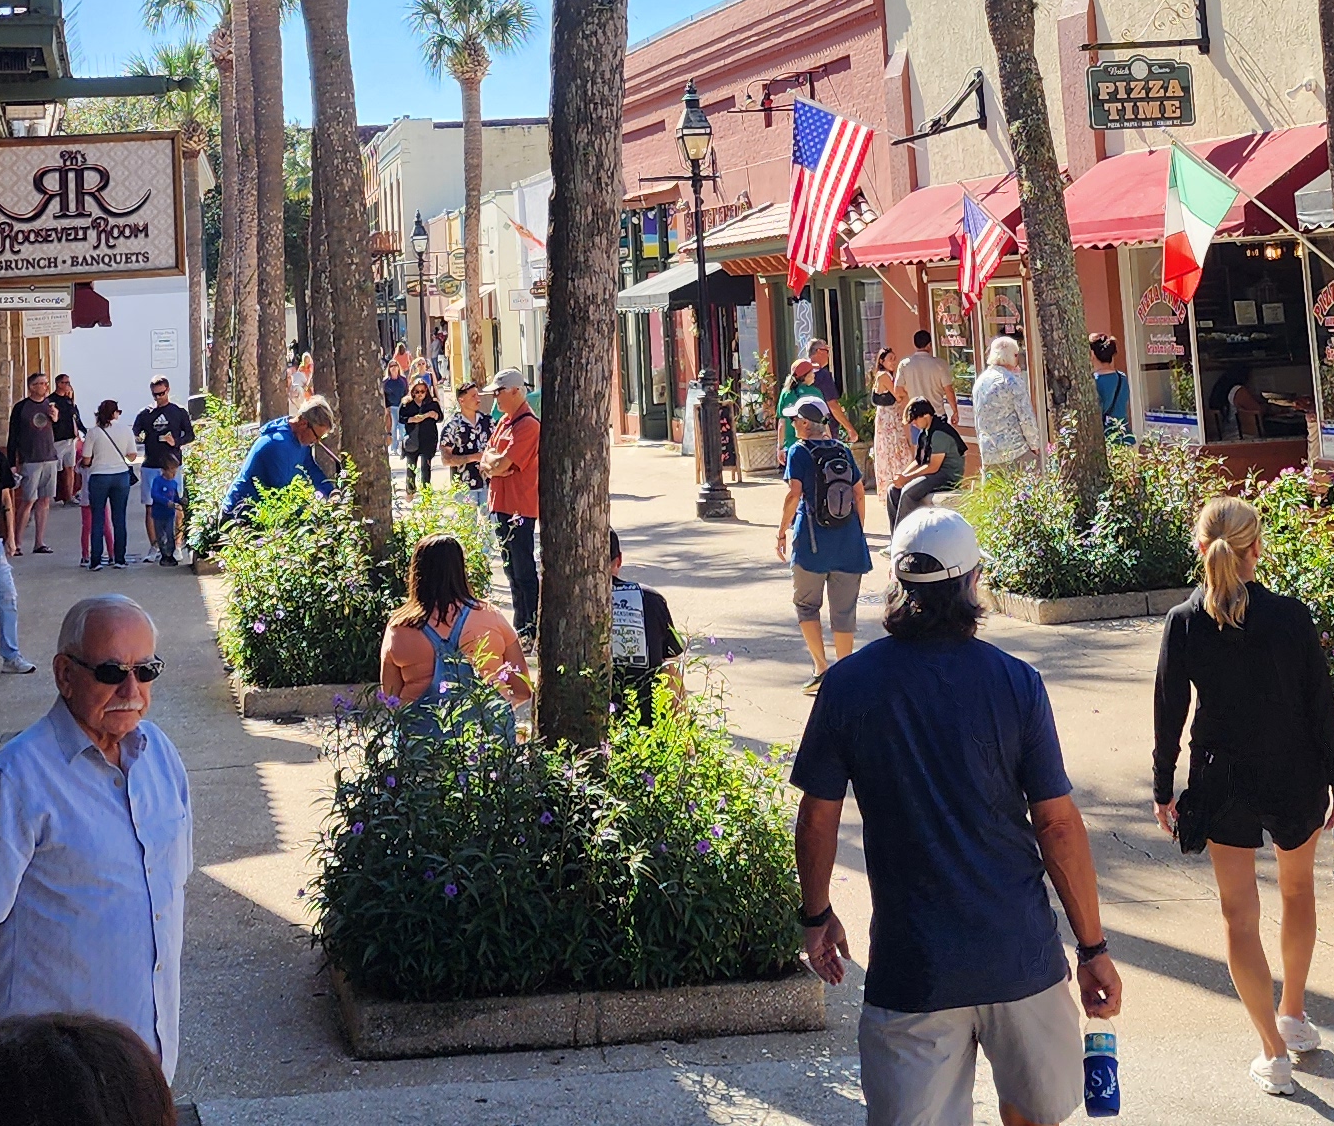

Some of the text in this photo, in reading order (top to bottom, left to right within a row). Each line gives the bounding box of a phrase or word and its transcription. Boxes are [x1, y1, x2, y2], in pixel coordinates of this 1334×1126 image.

[1097, 79, 1184, 100] PIZZA
[1103, 100, 1182, 120] TIME
[90, 215, 150, 249] ROOM
[70, 251, 151, 268] BANQUETS
[17, 296, 31, 304] St.
[33, 296, 65, 305] George
[1091, 1069, 1103, 1087] S
